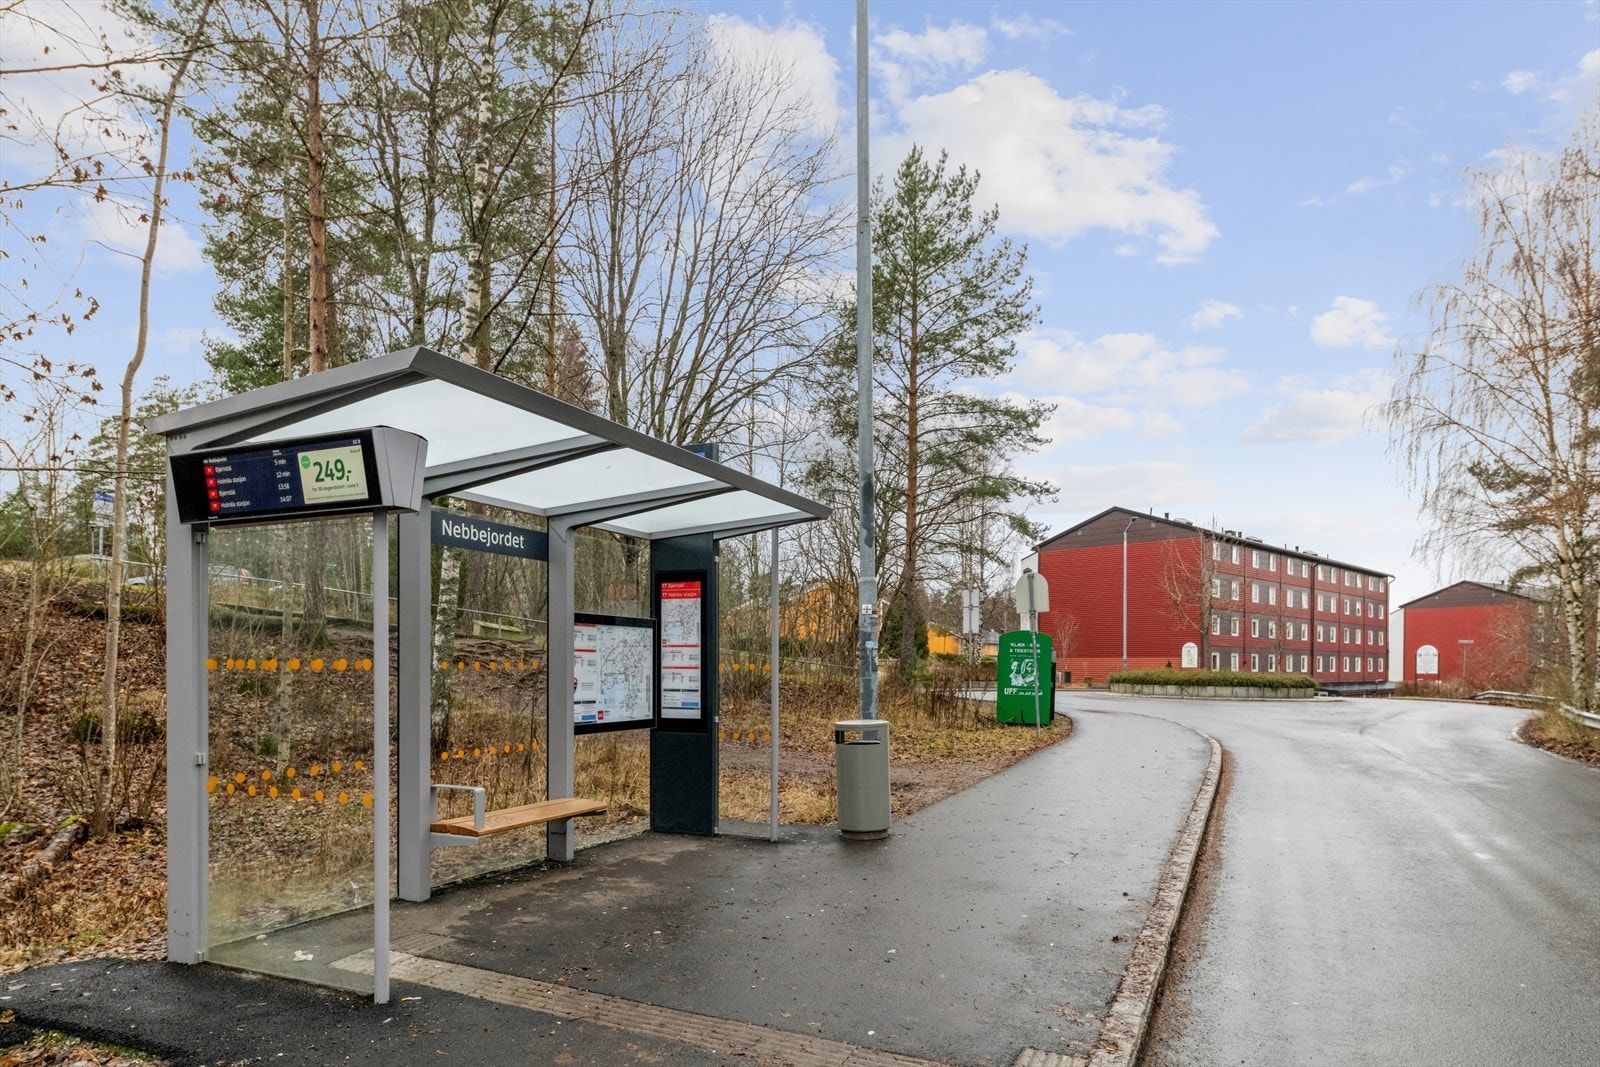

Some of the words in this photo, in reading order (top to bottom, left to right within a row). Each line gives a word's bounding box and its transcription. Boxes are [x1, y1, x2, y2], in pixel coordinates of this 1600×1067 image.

[313, 459, 352, 483] 249,-
[233, 476, 247, 484] stasjon
[280, 495, 292, 503] 14:07
[442, 519, 525, 549] Nebbejordet
